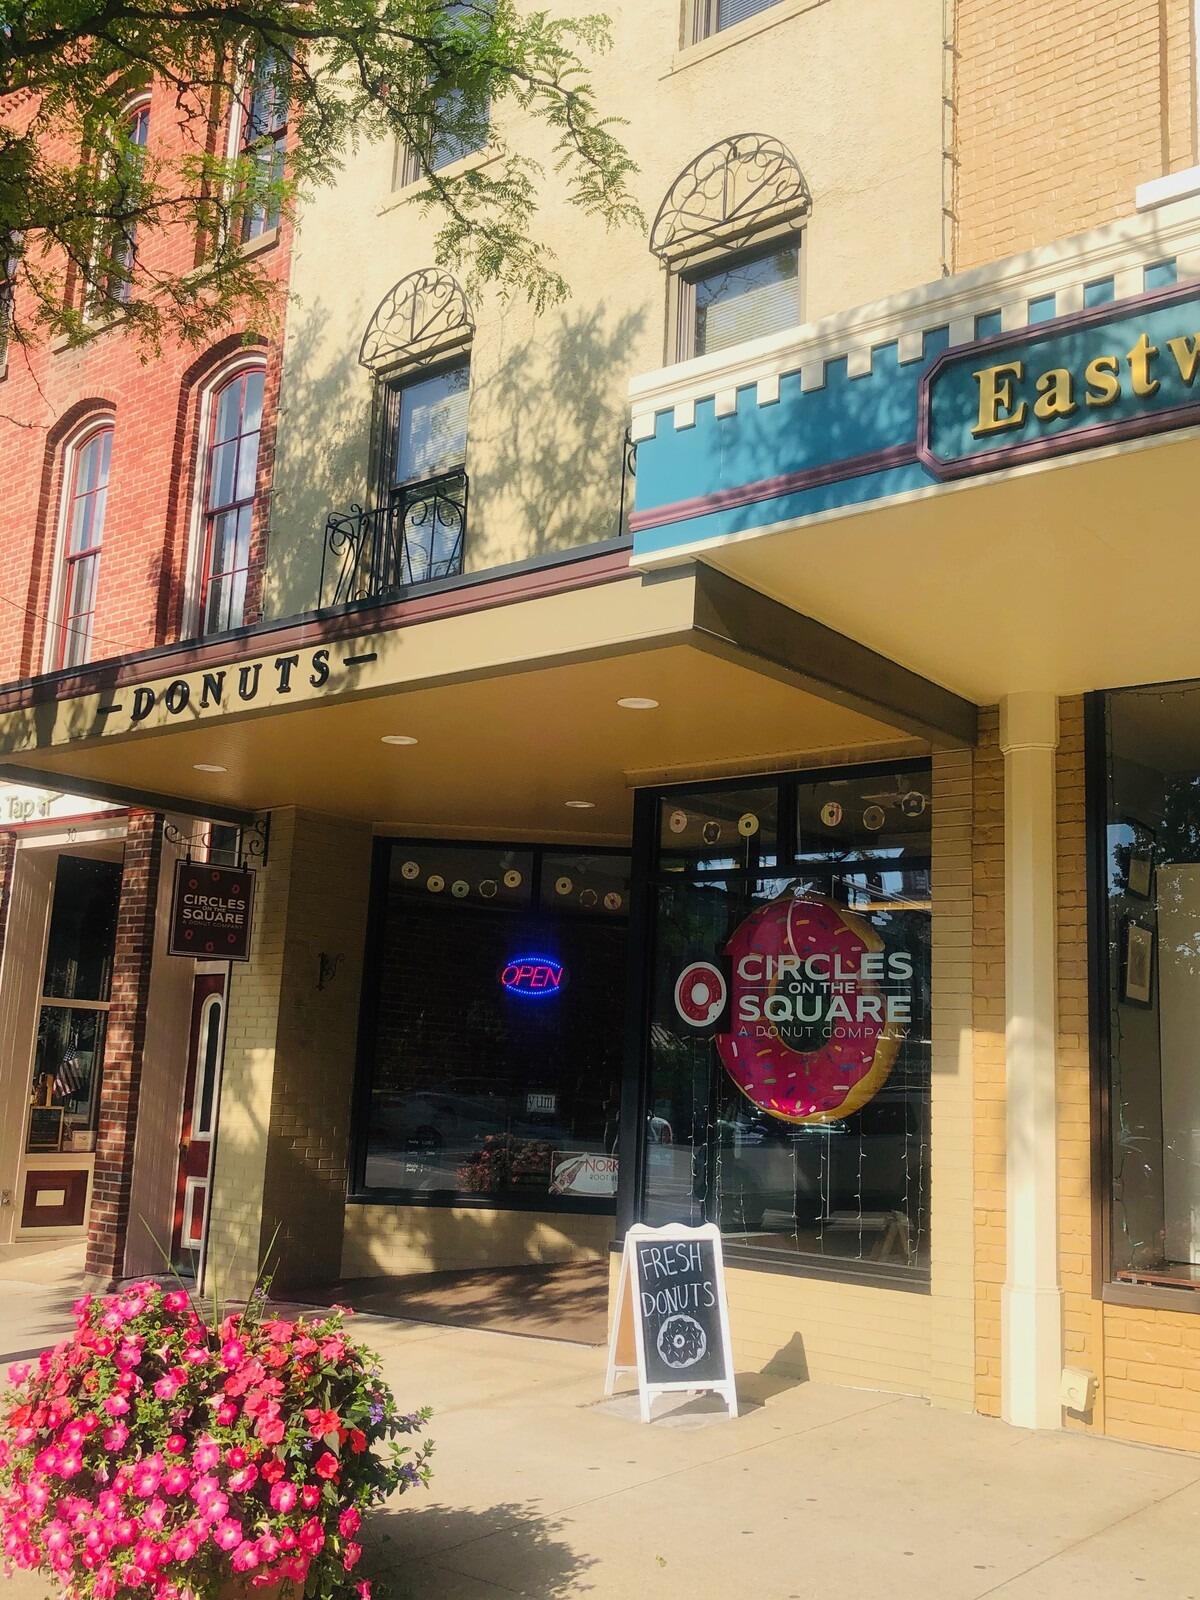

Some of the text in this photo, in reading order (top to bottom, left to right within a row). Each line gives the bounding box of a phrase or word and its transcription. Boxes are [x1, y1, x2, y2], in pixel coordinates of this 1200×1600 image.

[183, 894, 246, 910] CIRCLES
[182, 908, 244, 924] SQUARE
[501, 965, 563, 988] OPEN
[738, 952, 913, 981] CIRCLES
[788, 981, 856, 994] ON THE
[738, 995, 912, 1023] SQUARE
[739, 1026, 912, 1039] A DONUT COMPANY
[640, 1242, 702, 1281] FRESH
[641, 1281, 716, 1318] DONUTS
